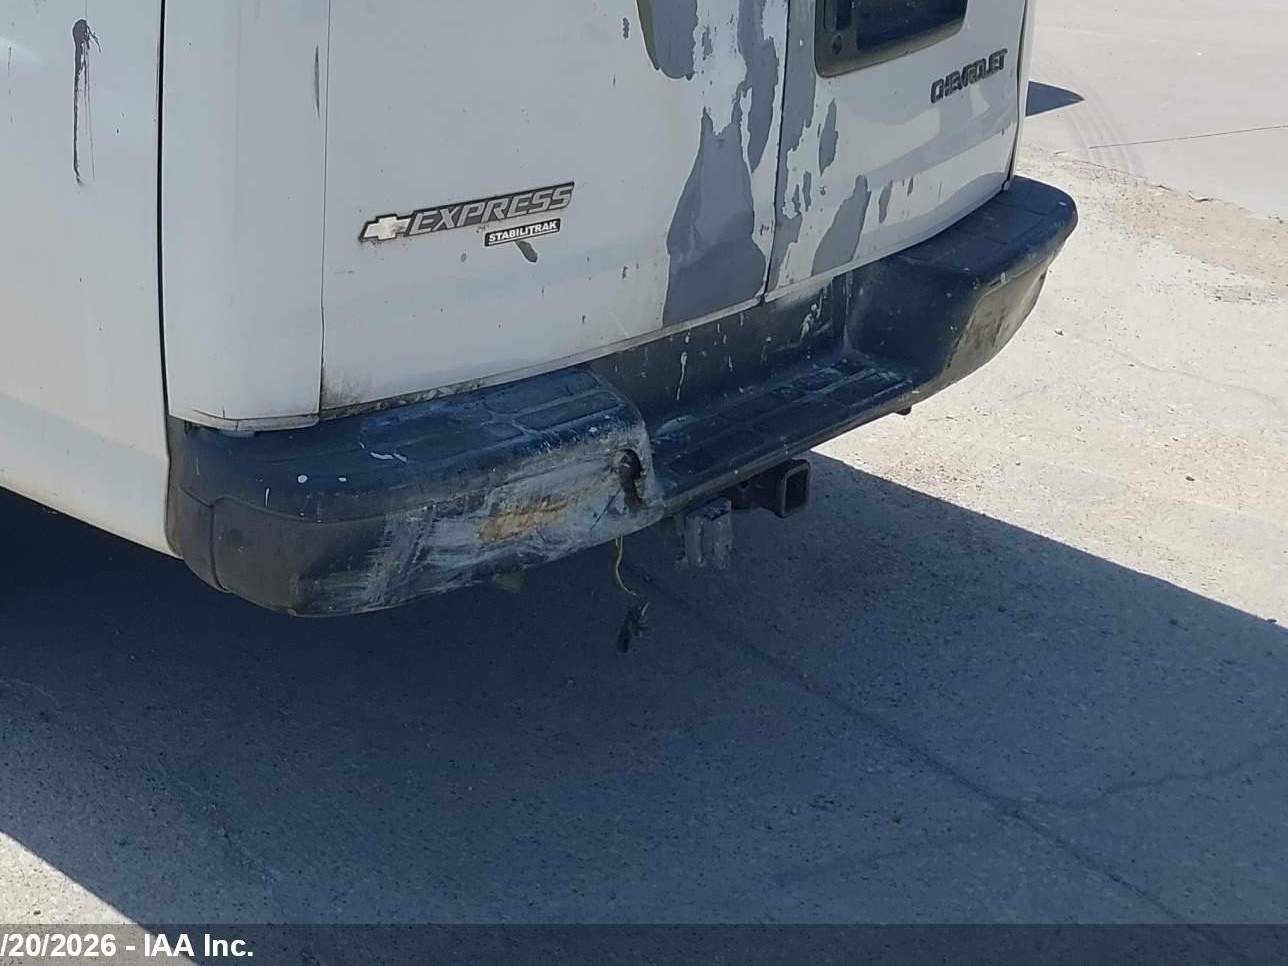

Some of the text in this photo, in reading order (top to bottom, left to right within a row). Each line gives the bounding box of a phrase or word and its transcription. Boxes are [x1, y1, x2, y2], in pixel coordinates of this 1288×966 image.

[930, 48, 1009, 104] CHEVROLET
[408, 185, 574, 235] EXPRESS
[487, 220, 559, 243] STABILITRAK
